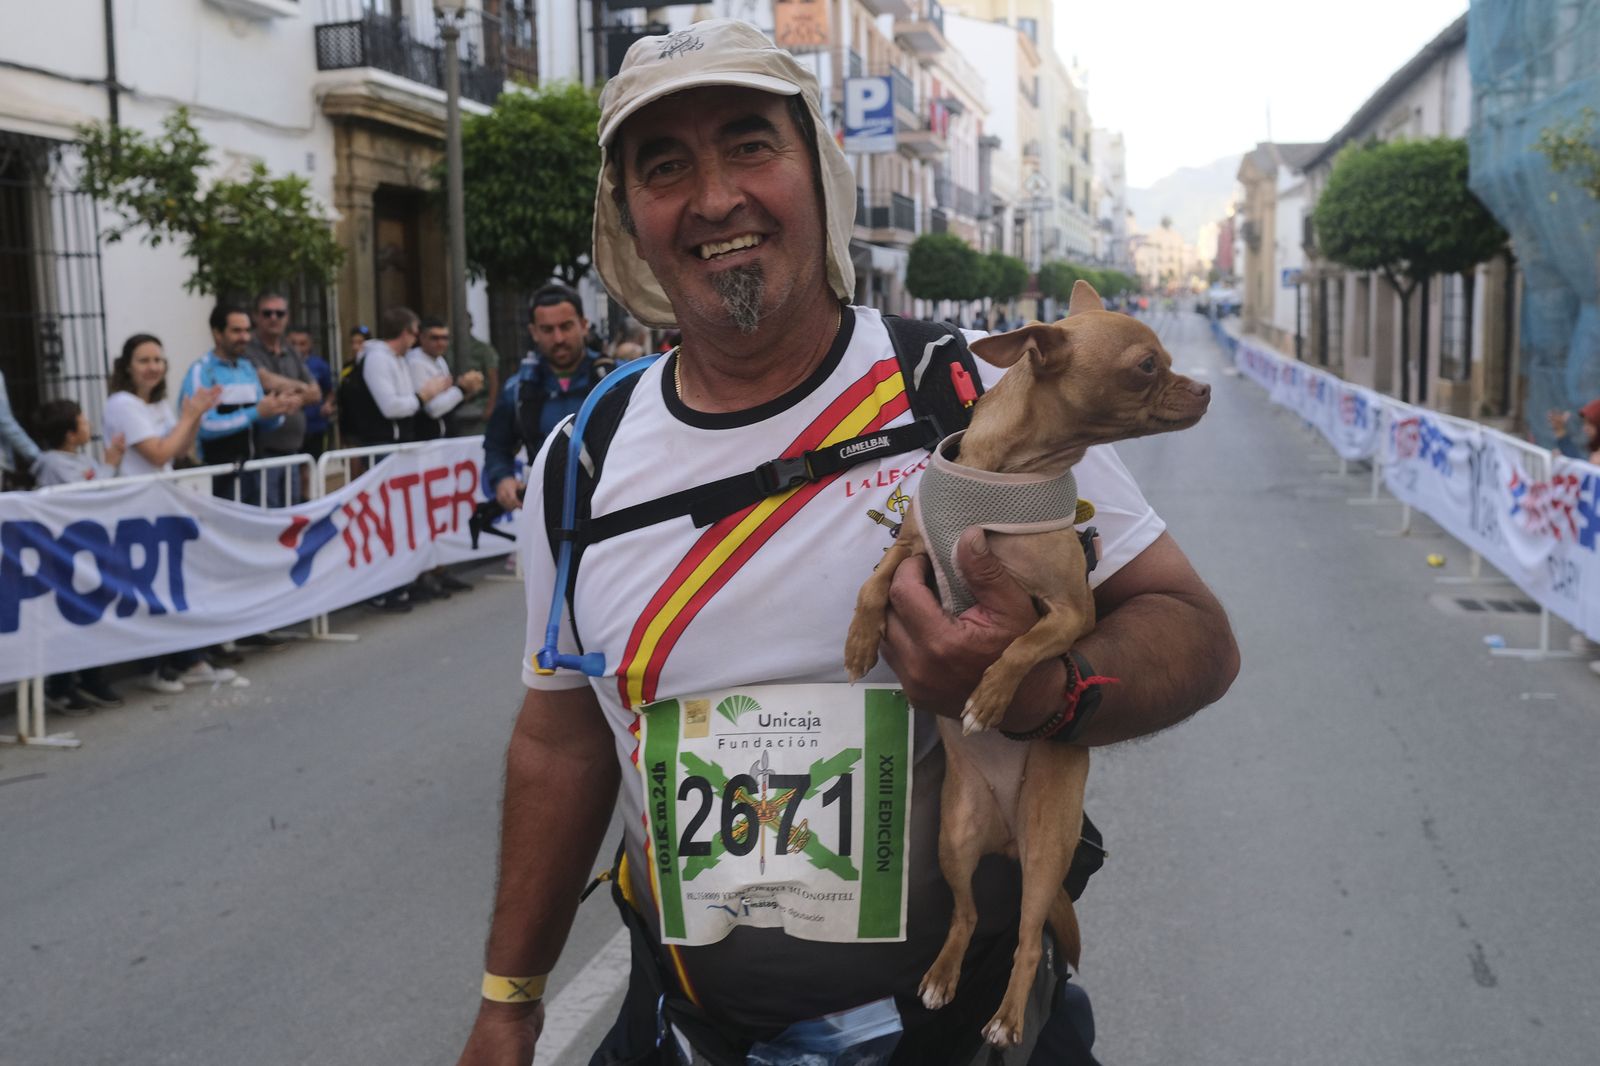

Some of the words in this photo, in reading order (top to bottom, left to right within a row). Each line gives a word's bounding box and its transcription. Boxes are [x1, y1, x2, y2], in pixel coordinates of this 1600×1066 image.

[845, 78, 890, 128] P
[839, 435, 891, 458] CAMELBAK
[342, 459, 477, 569] INTER
[717, 735, 819, 750] Fundación
[758, 710, 822, 730] Unicaja
[878, 754, 895, 796] XXIII
[676, 773, 853, 857] 2671
[876, 800, 895, 873] EDICIÓN
